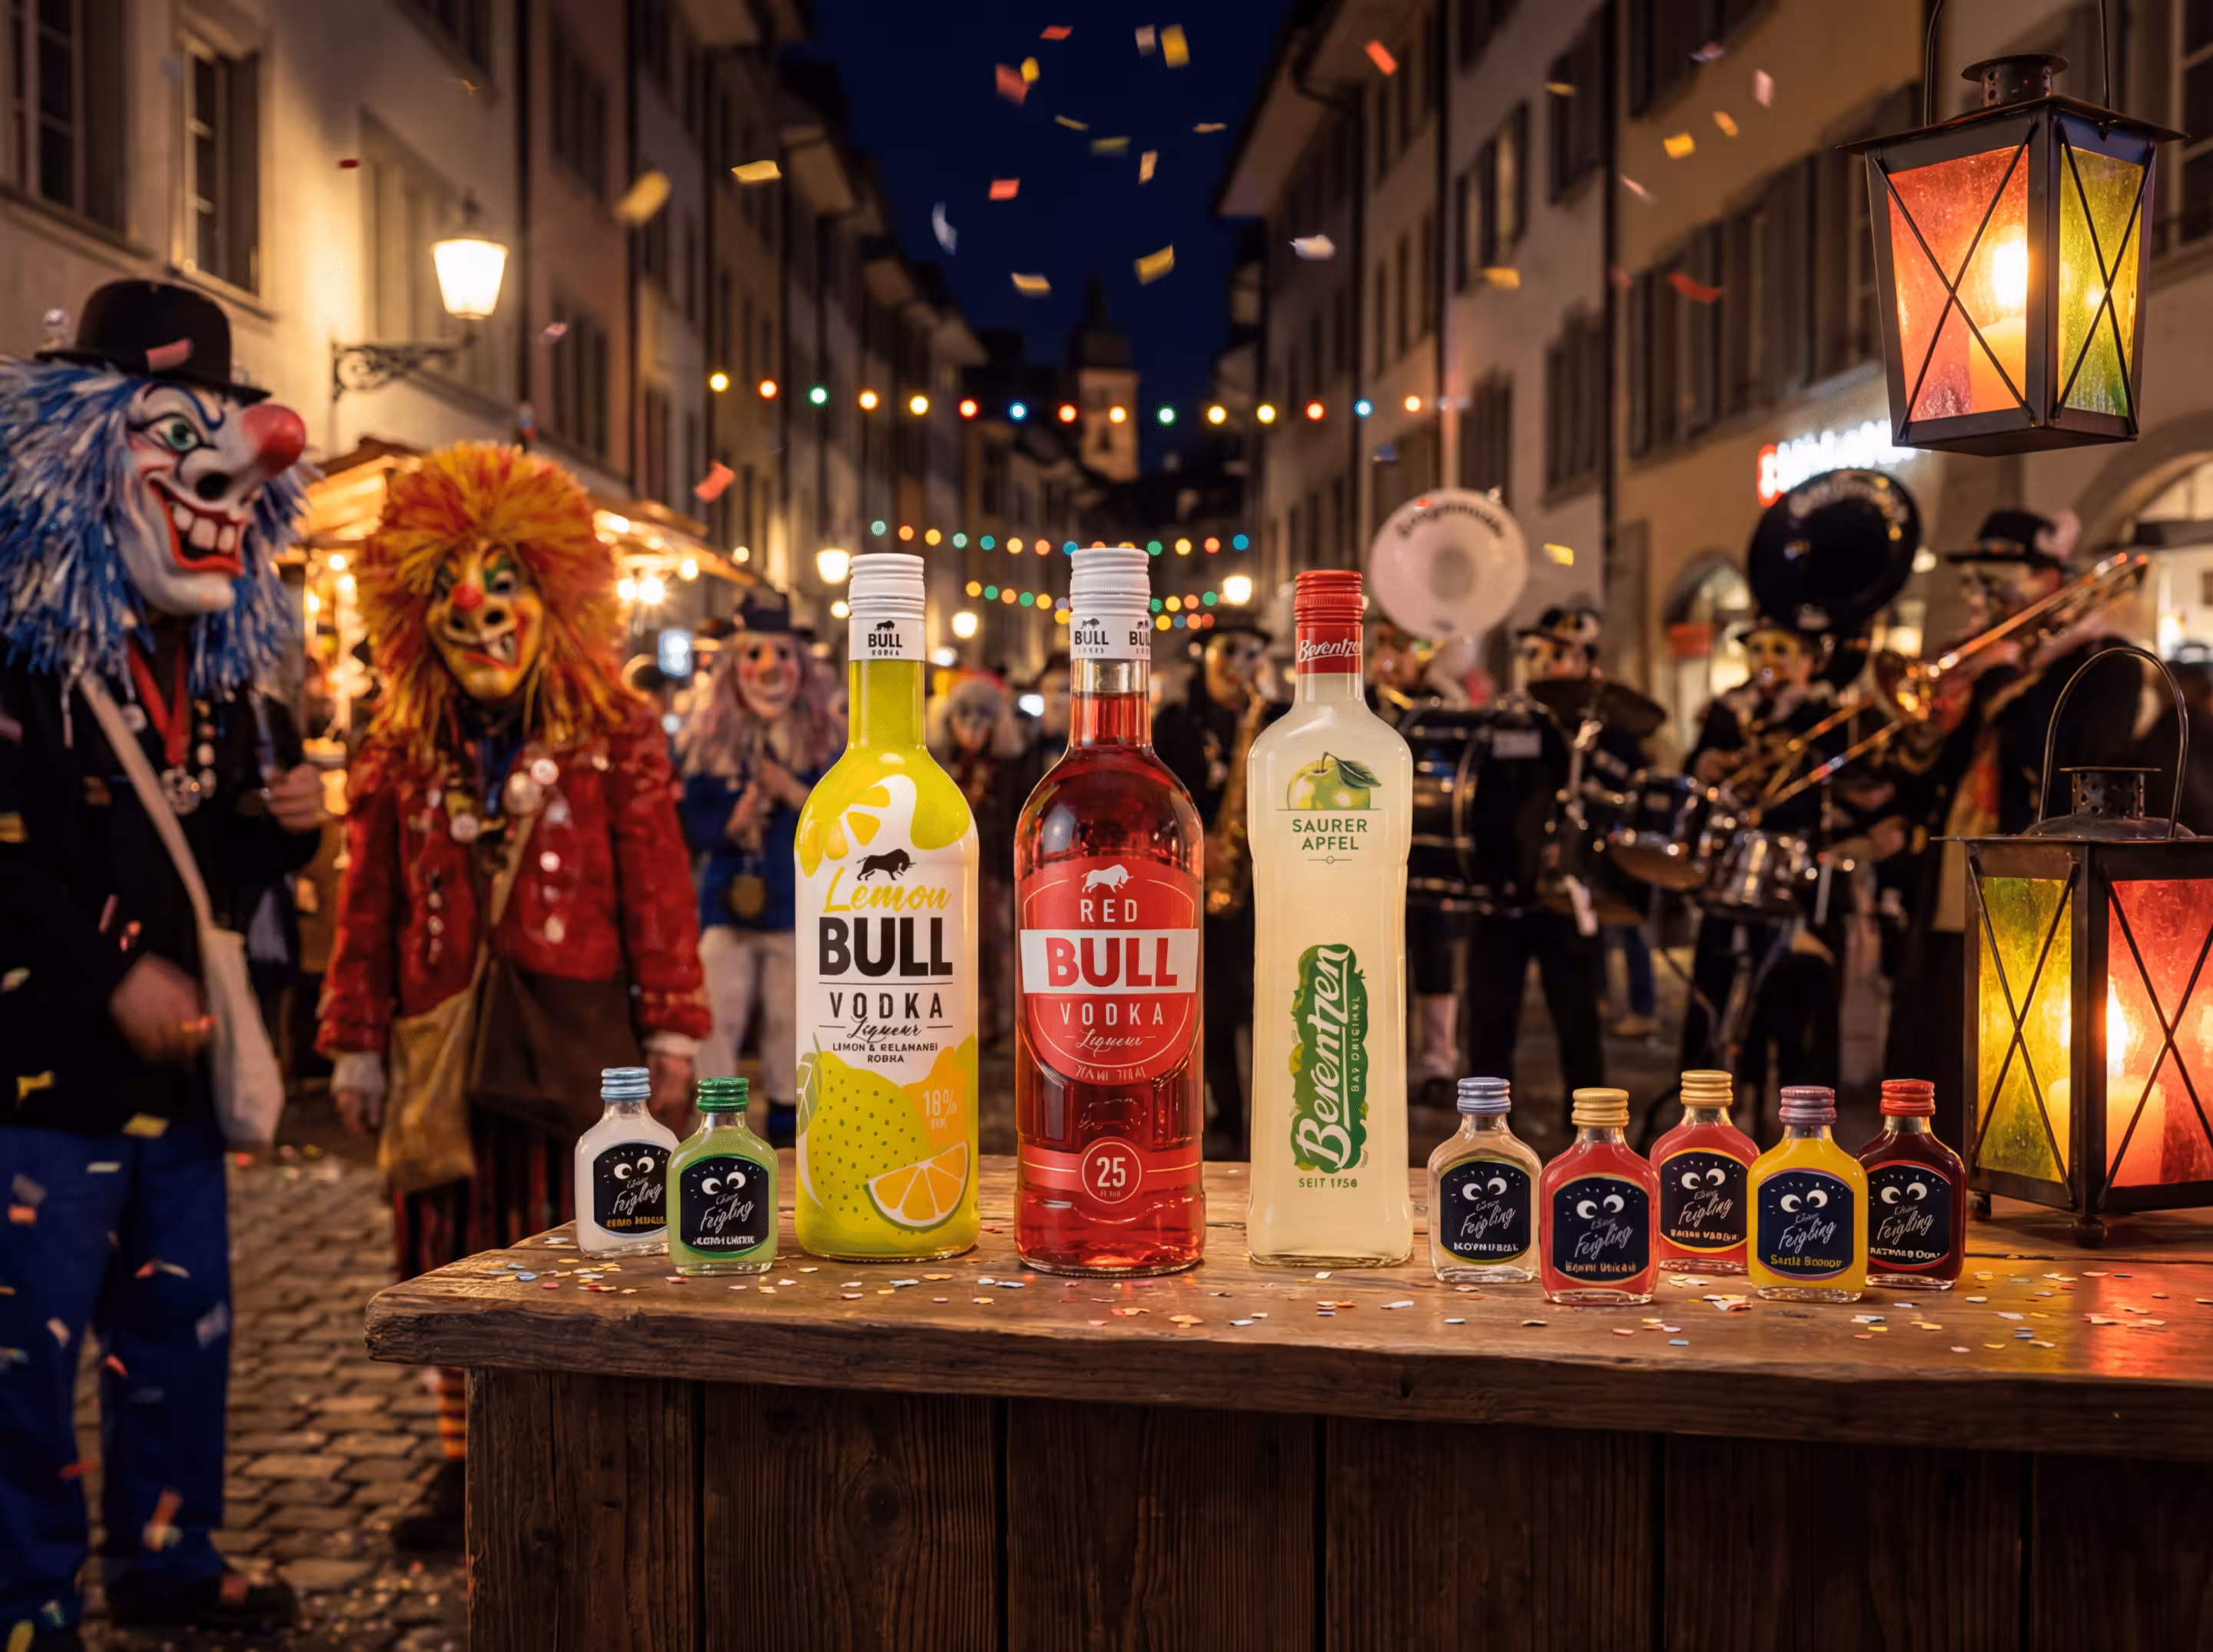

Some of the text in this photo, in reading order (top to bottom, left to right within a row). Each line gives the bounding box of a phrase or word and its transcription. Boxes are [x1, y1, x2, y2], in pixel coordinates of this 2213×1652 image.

[868, 633, 903, 648] BULL
[1074, 631, 1110, 645] BULL
[1292, 818, 1368, 833] SAURER
[1301, 836, 1359, 851] APFEL
[823, 866, 952, 914] Lemon
[1080, 898, 1138, 923] RED
[818, 916, 954, 977] BULL
[1045, 937, 1178, 988] BULL
[829, 991, 944, 1020] VODKA
[1060, 1002, 1163, 1026] VODKA
[846, 1016, 923, 1044] Liqueur
[1076, 1028, 1144, 1058] Liqueur
[832, 1043, 865, 1052] LIMON
[1296, 946, 1351, 1169] Berentzen
[922, 1089, 958, 1117] 18%
[1096, 1156, 1126, 1188] 25
[1298, 1177, 1326, 1189] SEIT
